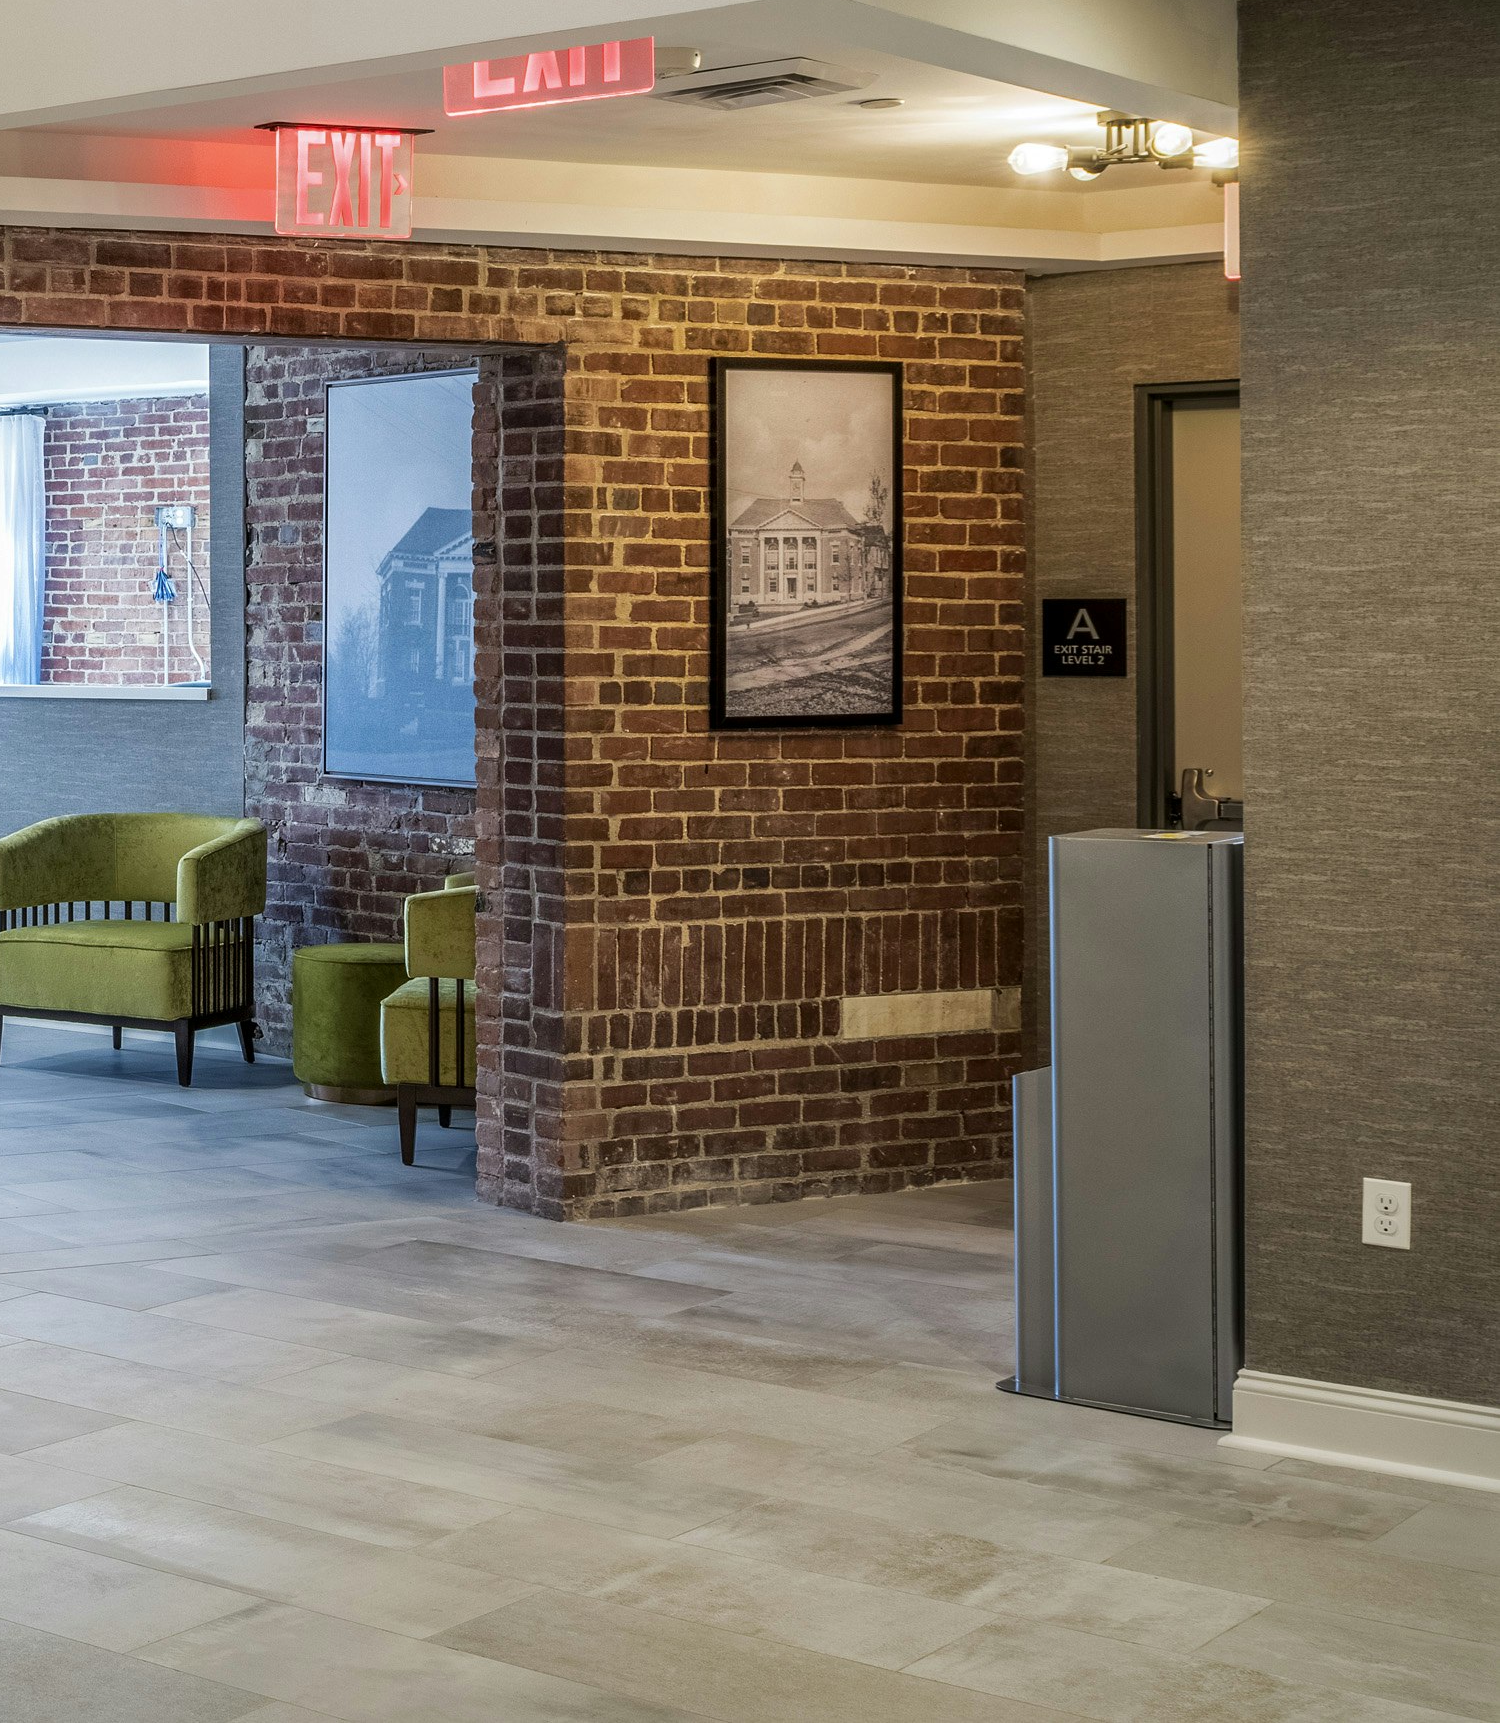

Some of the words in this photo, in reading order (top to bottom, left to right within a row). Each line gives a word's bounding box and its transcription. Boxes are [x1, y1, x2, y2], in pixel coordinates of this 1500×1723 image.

[296, 130, 401, 228] EXIT
[1066, 608, 1100, 640] A
[1054, 645, 1078, 654] EXIT
[1081, 645, 1112, 654] STAIR
[1062, 656, 1094, 665] LEVEL
[1097, 656, 1105, 665] 2
